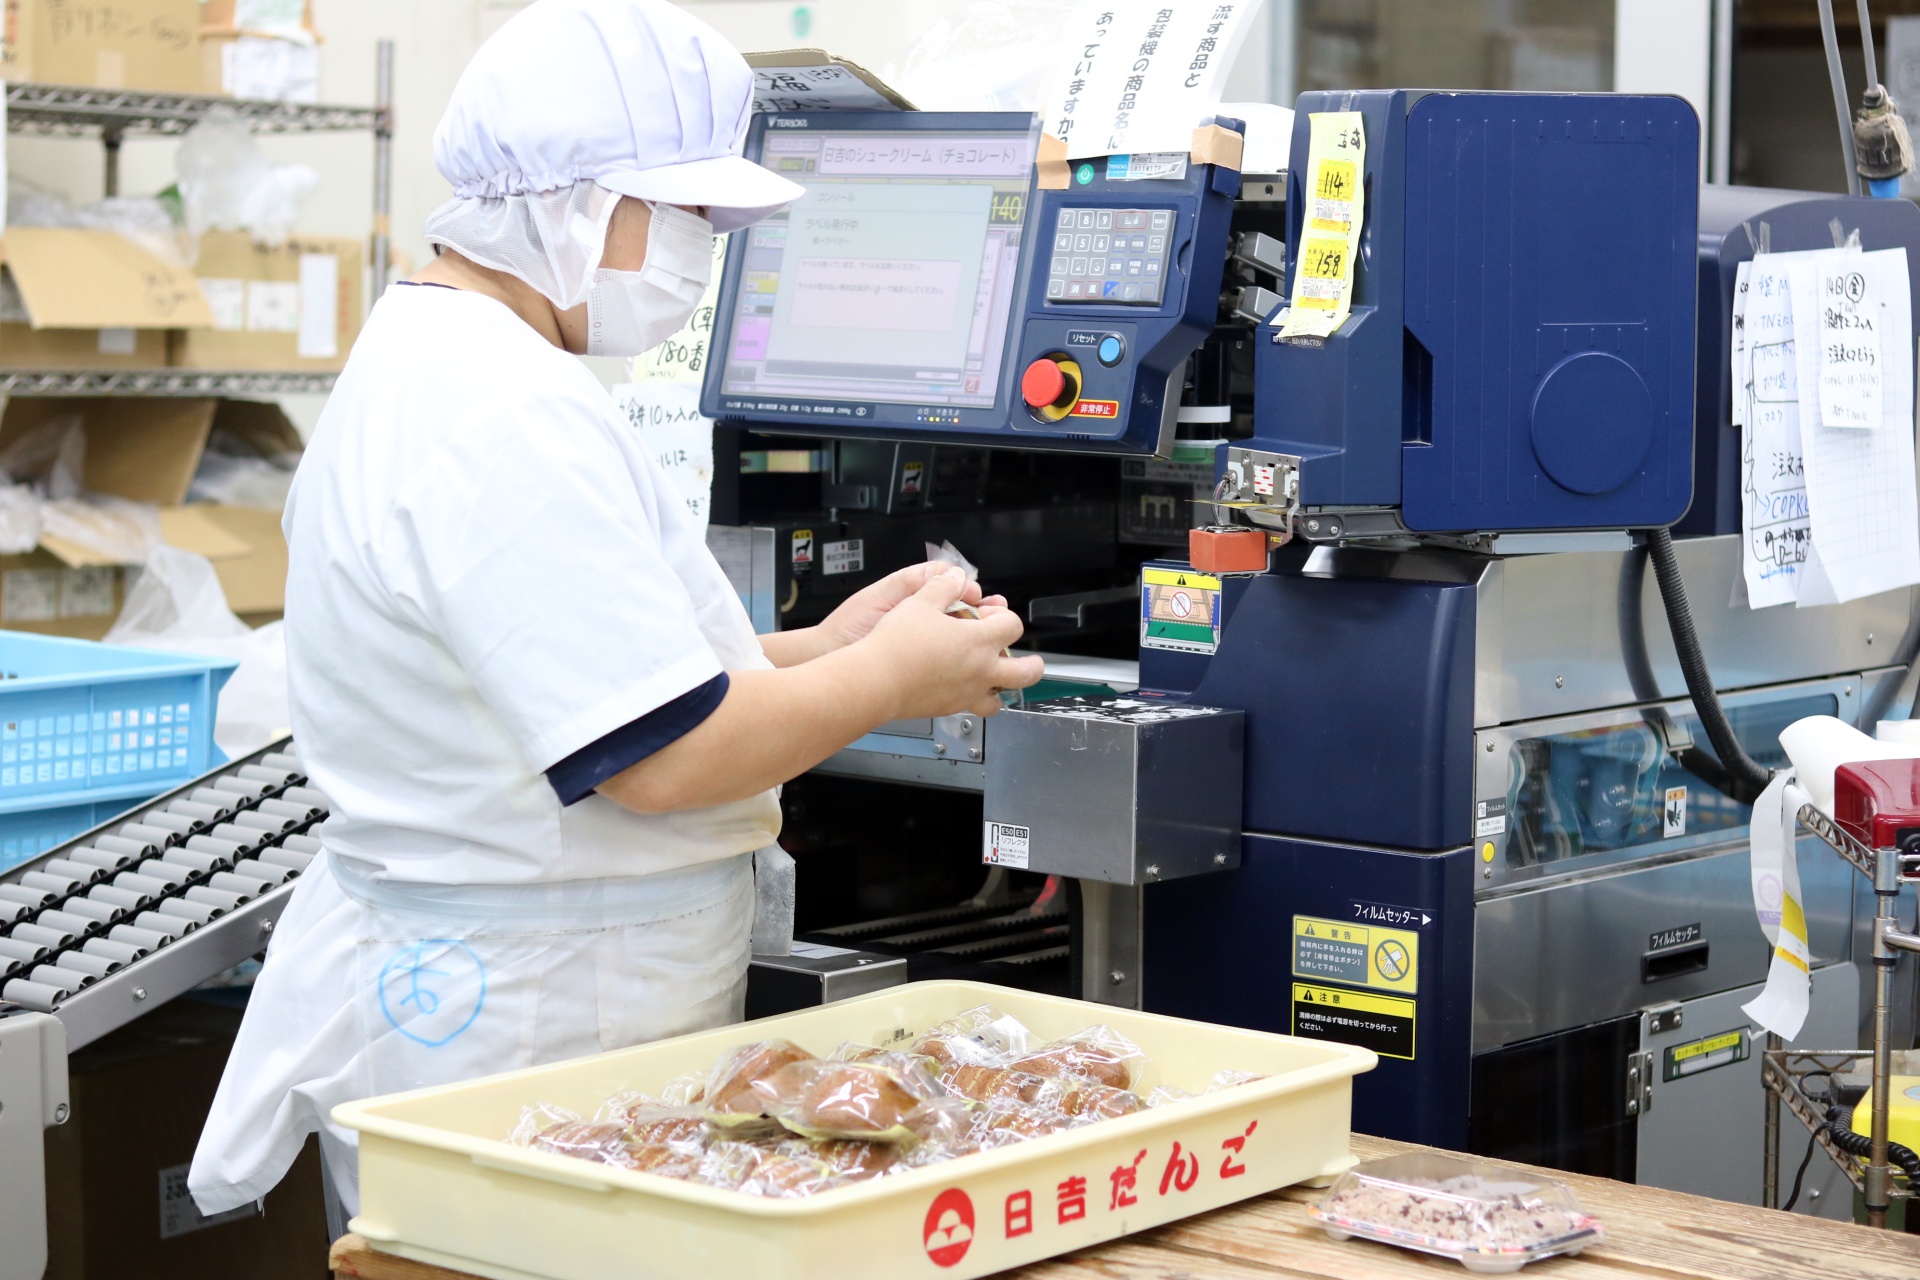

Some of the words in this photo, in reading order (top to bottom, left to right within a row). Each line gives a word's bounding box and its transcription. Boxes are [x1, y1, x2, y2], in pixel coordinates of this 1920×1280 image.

[1184, 4, 1234, 89] 流す商品と
[1106, 8, 1173, 150] 包装機の商品名に
[777, 118, 808, 127] TERAOKA
[1324, 171, 1343, 197] 114
[991, 197, 1023, 221] 140
[805, 219, 860, 231] ラベル発行中
[1063, 215, 1070, 224] 7
[1083, 215, 1089, 225] 8
[1102, 216, 1108, 225] 9
[1060, 238, 1066, 247] 4
[1079, 238, 1086, 248] 5
[1098, 239, 1104, 249] 6
[1316, 252, 1341, 277] 158
[1072, 334, 1096, 343] リセット
[1080, 404, 1111, 415] 非常停止
[1001, 827, 1014, 836] E50
[1015, 829, 1028, 838] E51
[1001, 837, 1027, 847] リフレクタ
[1353, 904, 1419, 924] フィルムセッター
[1331, 928, 1352, 940] 警告
[1652, 928, 1699, 948] フィルムセッター
[1300, 940, 1364, 956] 機械内に手を入れる時は
[1300, 960, 1344, 973] を押して下さい。
[1319, 992, 1341, 1004] 注意
[1298, 1011, 1398, 1033] 清掃の際は必ず電源を切ってから行って
[1298, 1022, 1324, 1032] ください。
[1005, 1120, 1258, 1239] 日吉だんご
